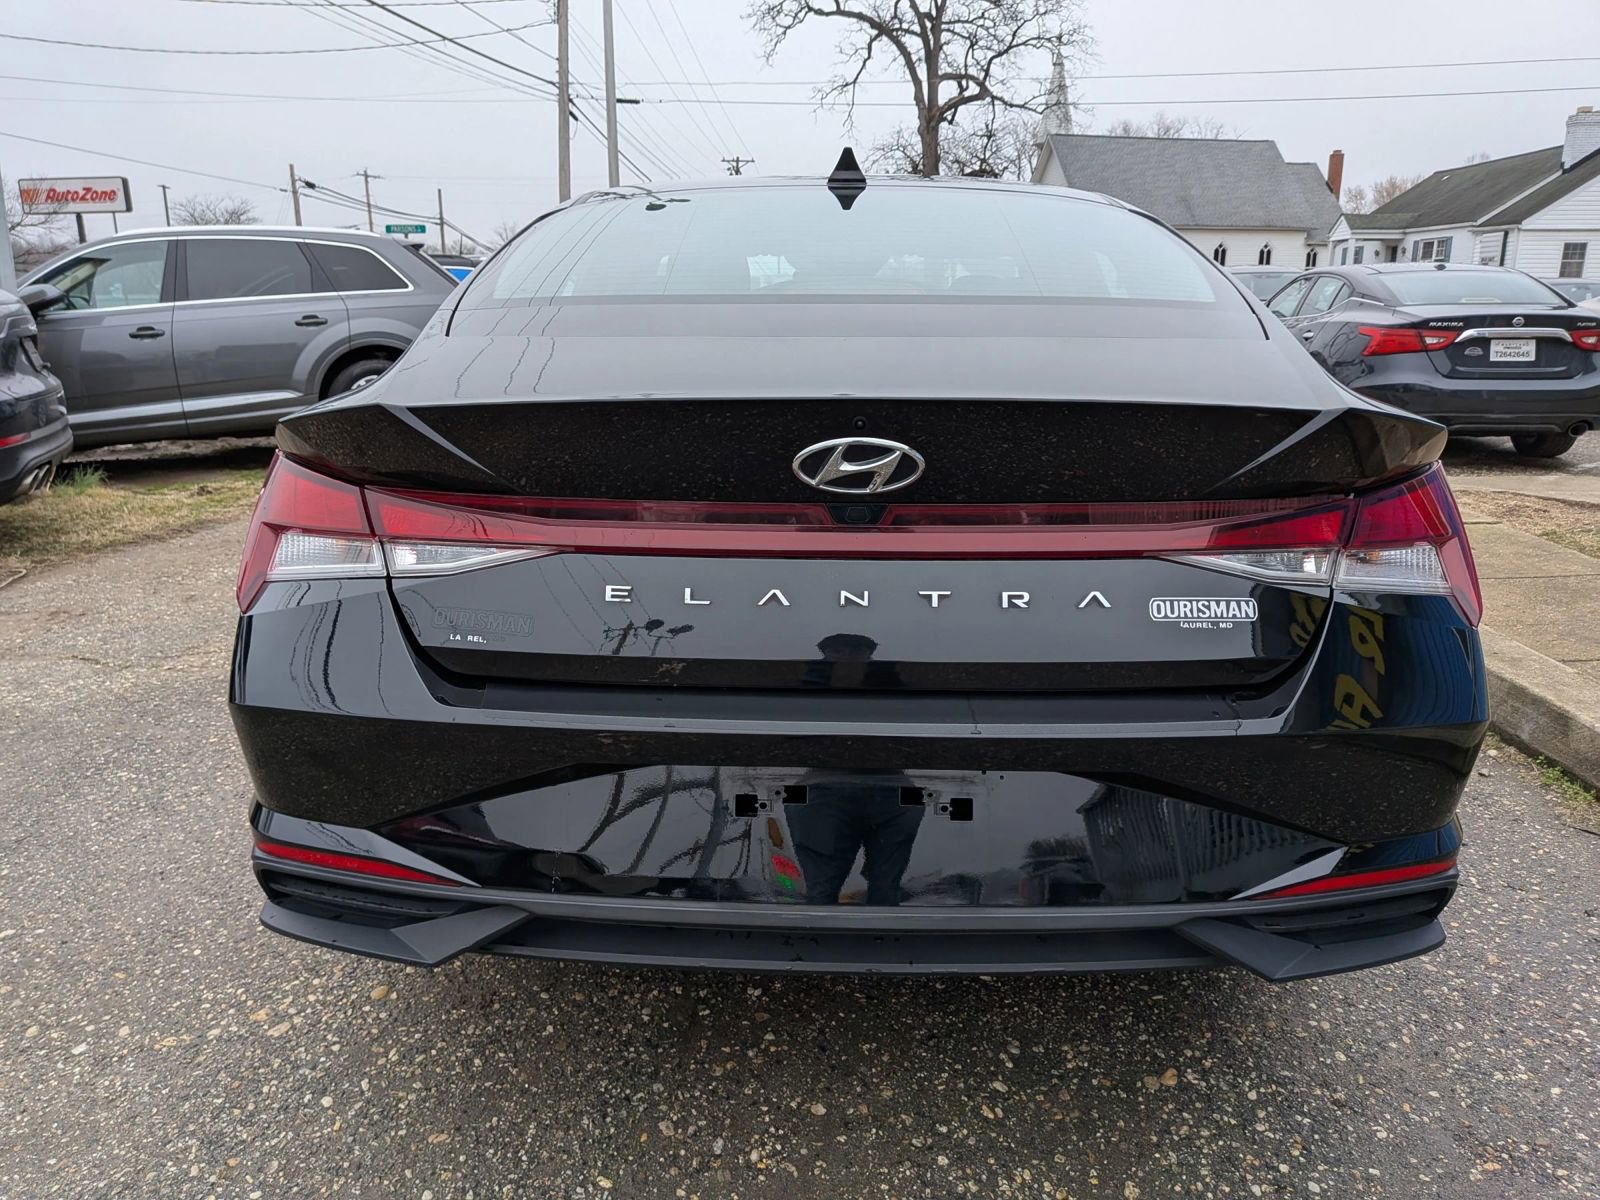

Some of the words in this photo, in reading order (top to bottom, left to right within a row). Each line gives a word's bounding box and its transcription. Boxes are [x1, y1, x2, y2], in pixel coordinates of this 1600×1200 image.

[45, 187, 117, 202] AutoZone
[604, 585, 1112, 609] ELANTRA
[1152, 601, 1254, 618] OURISMAN
[1219, 621, 1233, 629] MD
